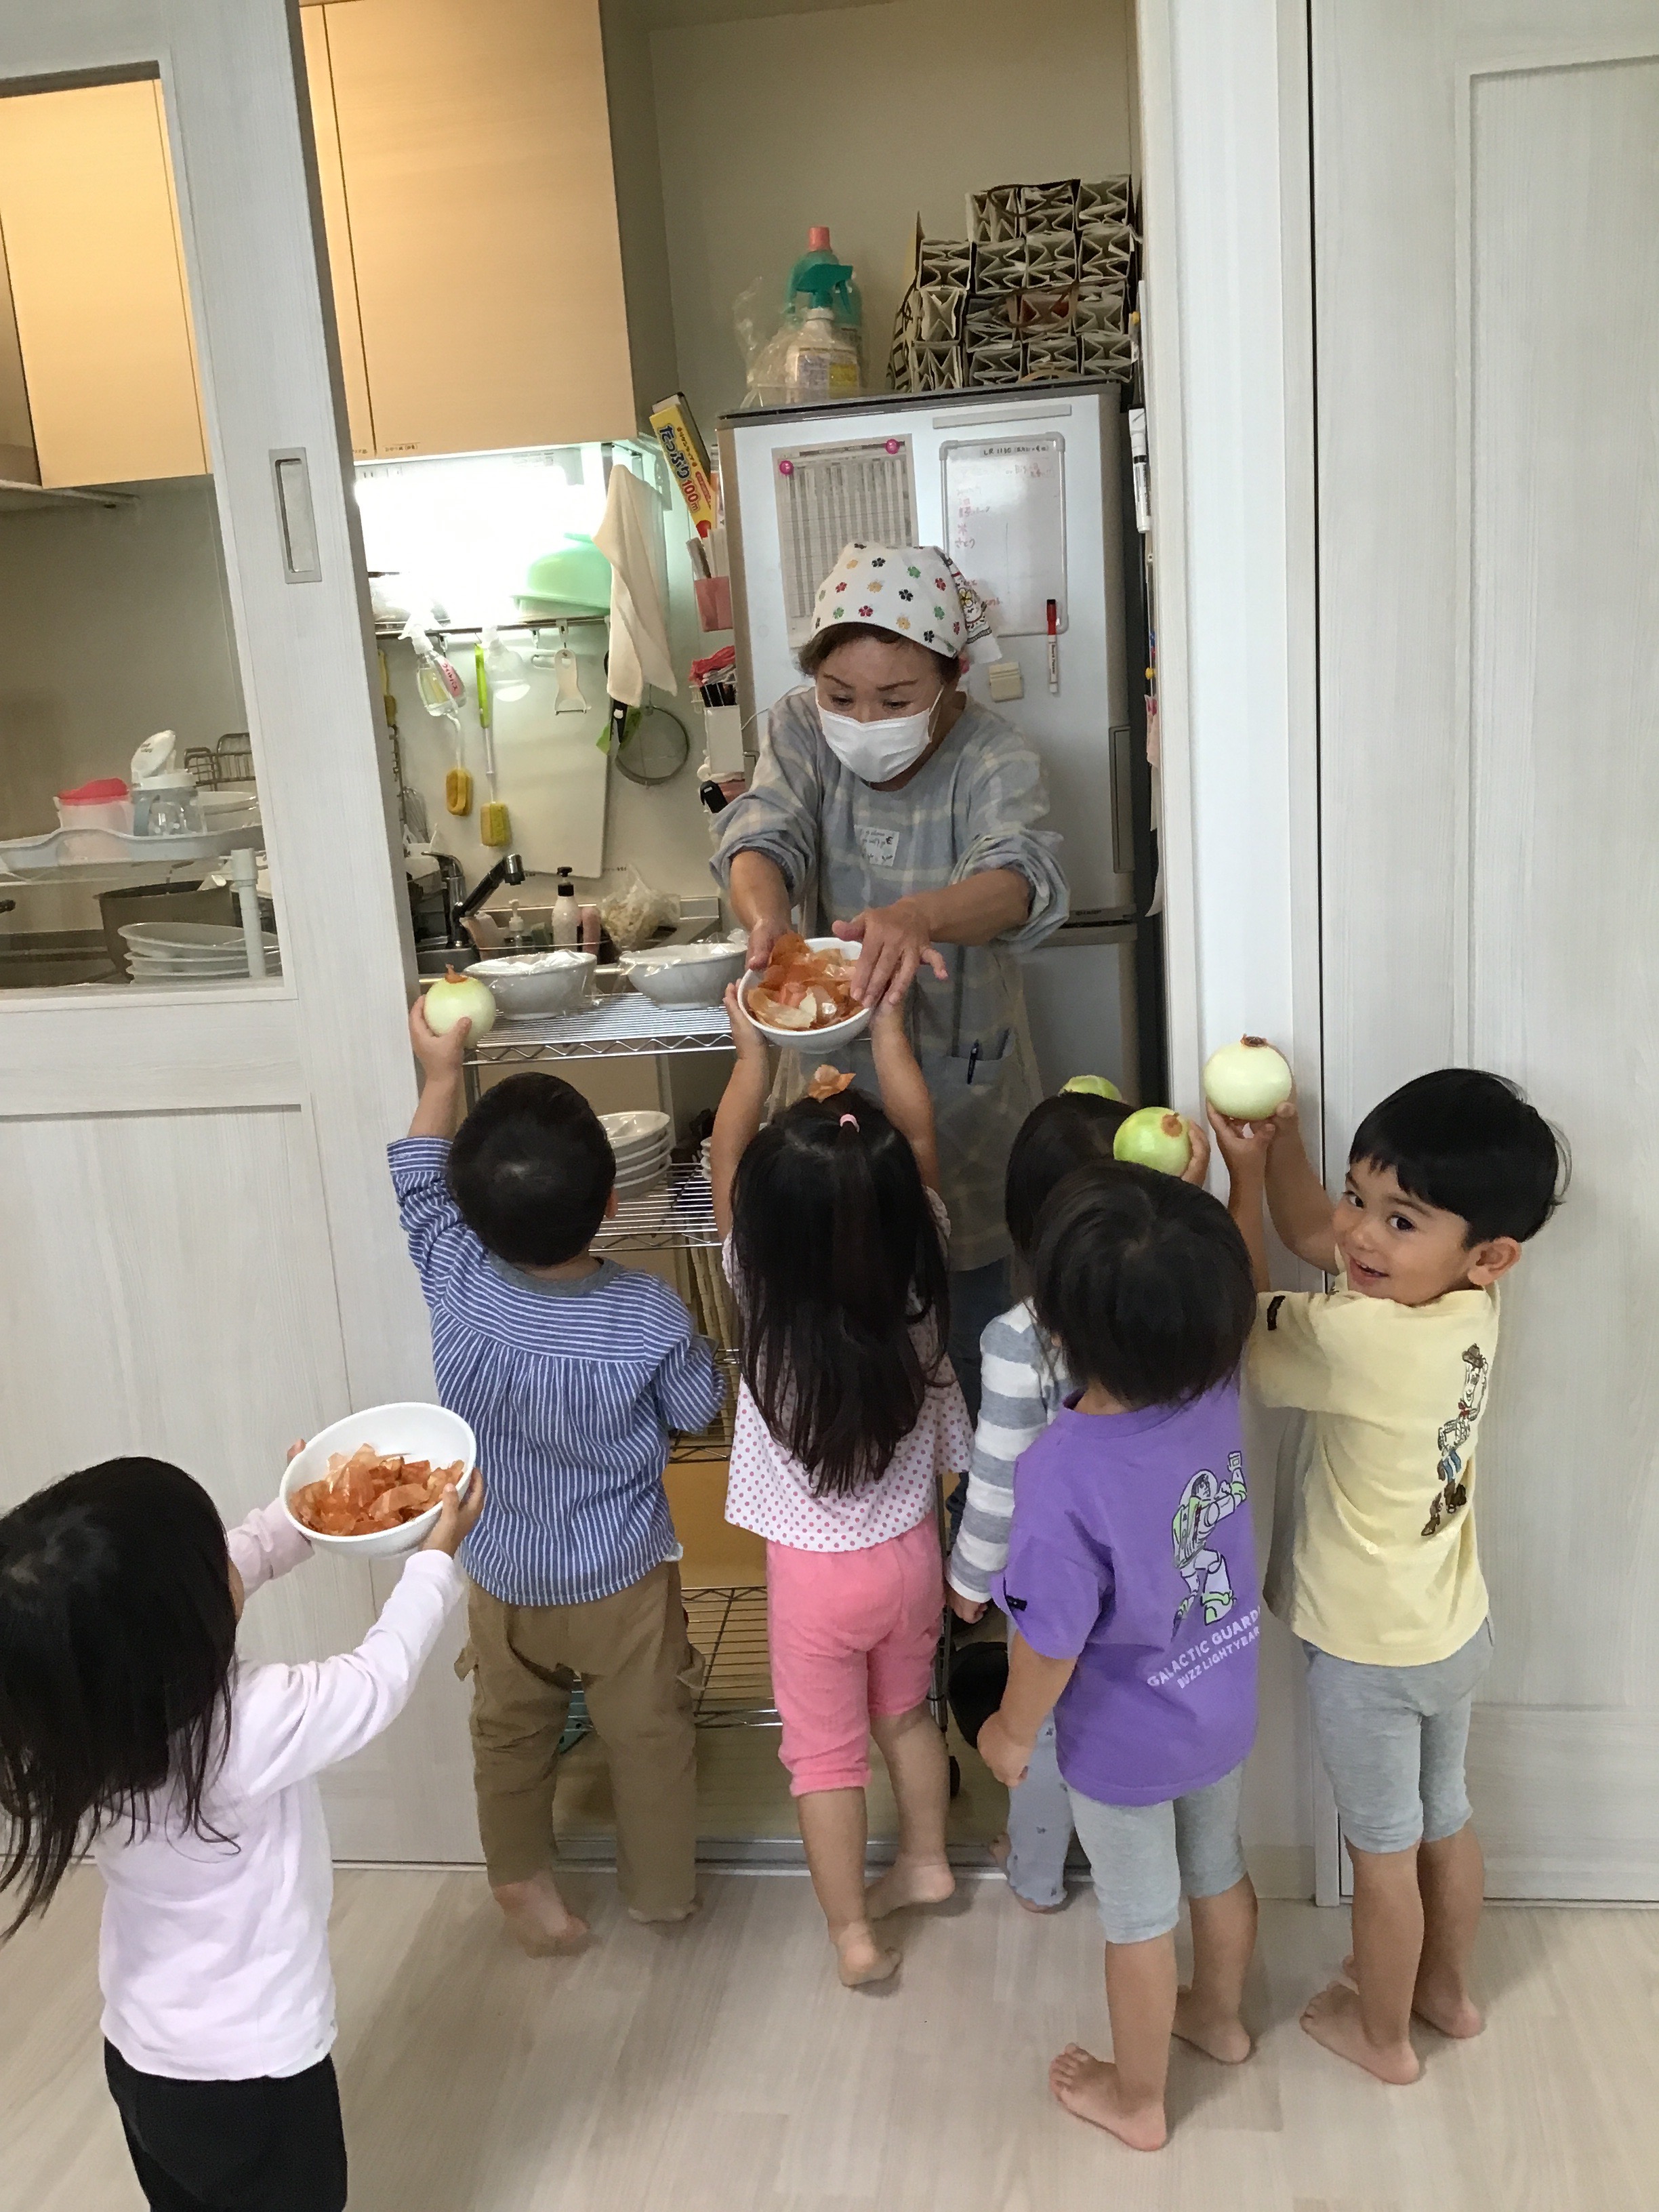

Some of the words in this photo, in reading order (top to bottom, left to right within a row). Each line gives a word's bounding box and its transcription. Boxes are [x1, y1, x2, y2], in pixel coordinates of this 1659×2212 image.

[658, 424, 691, 479] たっぷり
[1147, 1639, 1210, 1687] GALACTIC
[1202, 1626, 1260, 1671] LIGHTYEAR
